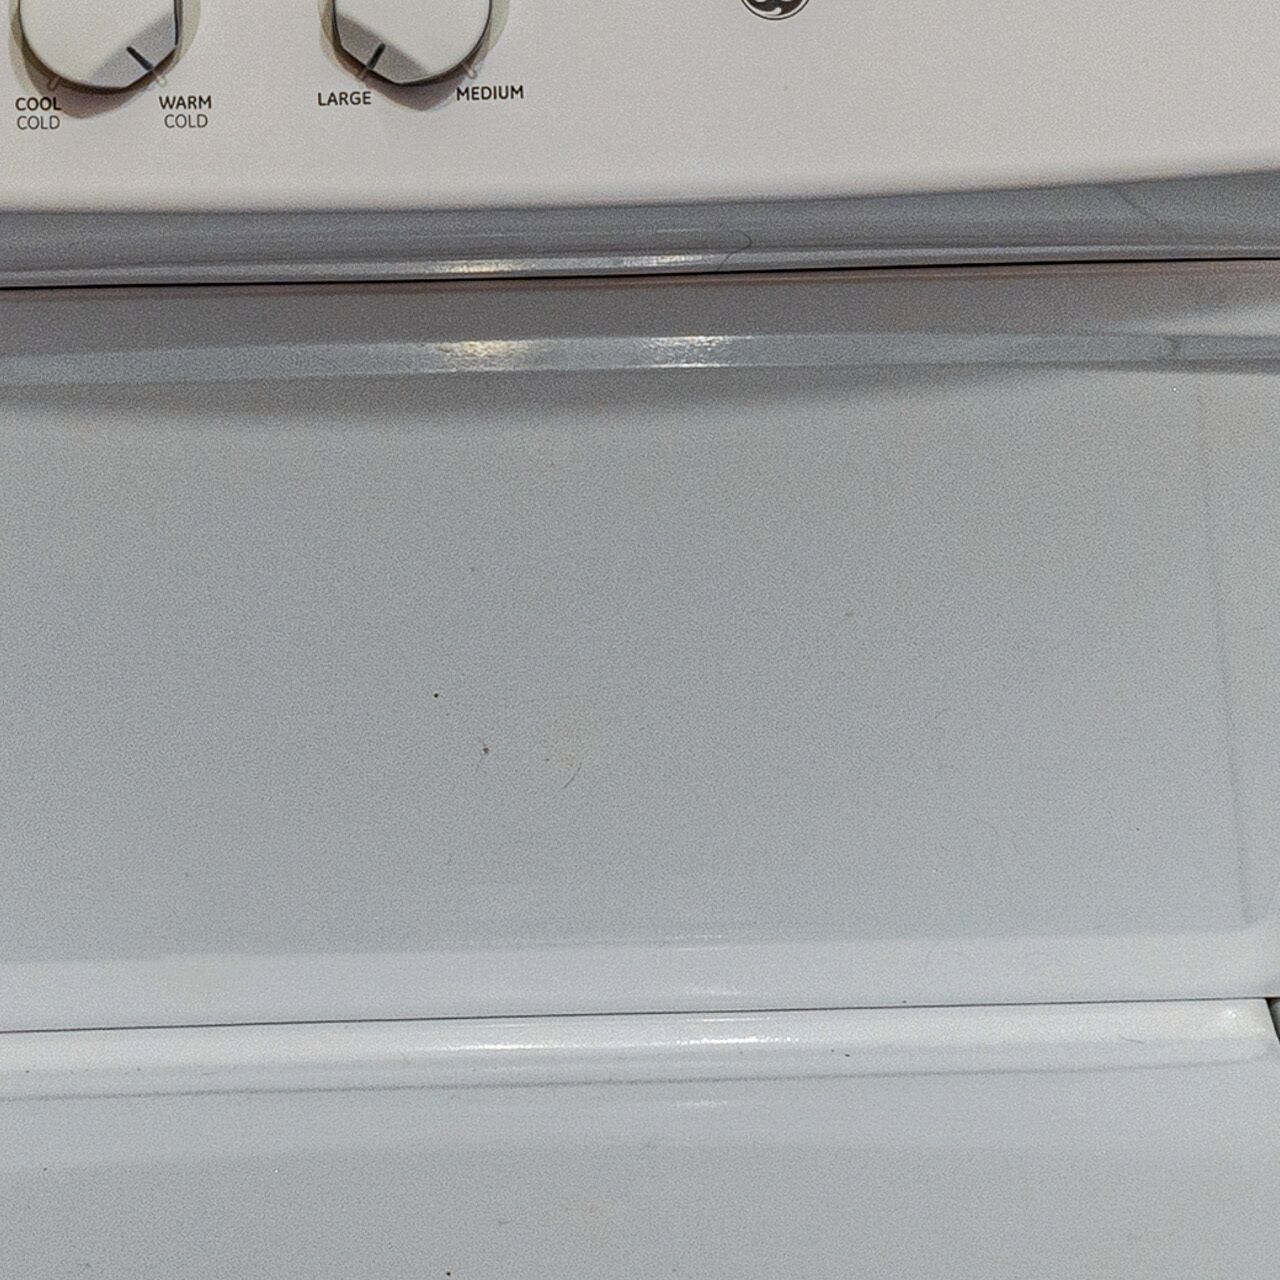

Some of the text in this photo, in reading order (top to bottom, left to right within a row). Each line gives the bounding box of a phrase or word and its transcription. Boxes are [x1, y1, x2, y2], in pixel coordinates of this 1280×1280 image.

[318, 91, 371, 106] LARGE
[456, 84, 524, 102] MEDIUM
[16, 95, 62, 111] COOL
[159, 95, 212, 109] WARM
[17, 115, 60, 130] COLD
[164, 113, 208, 129] COLD
